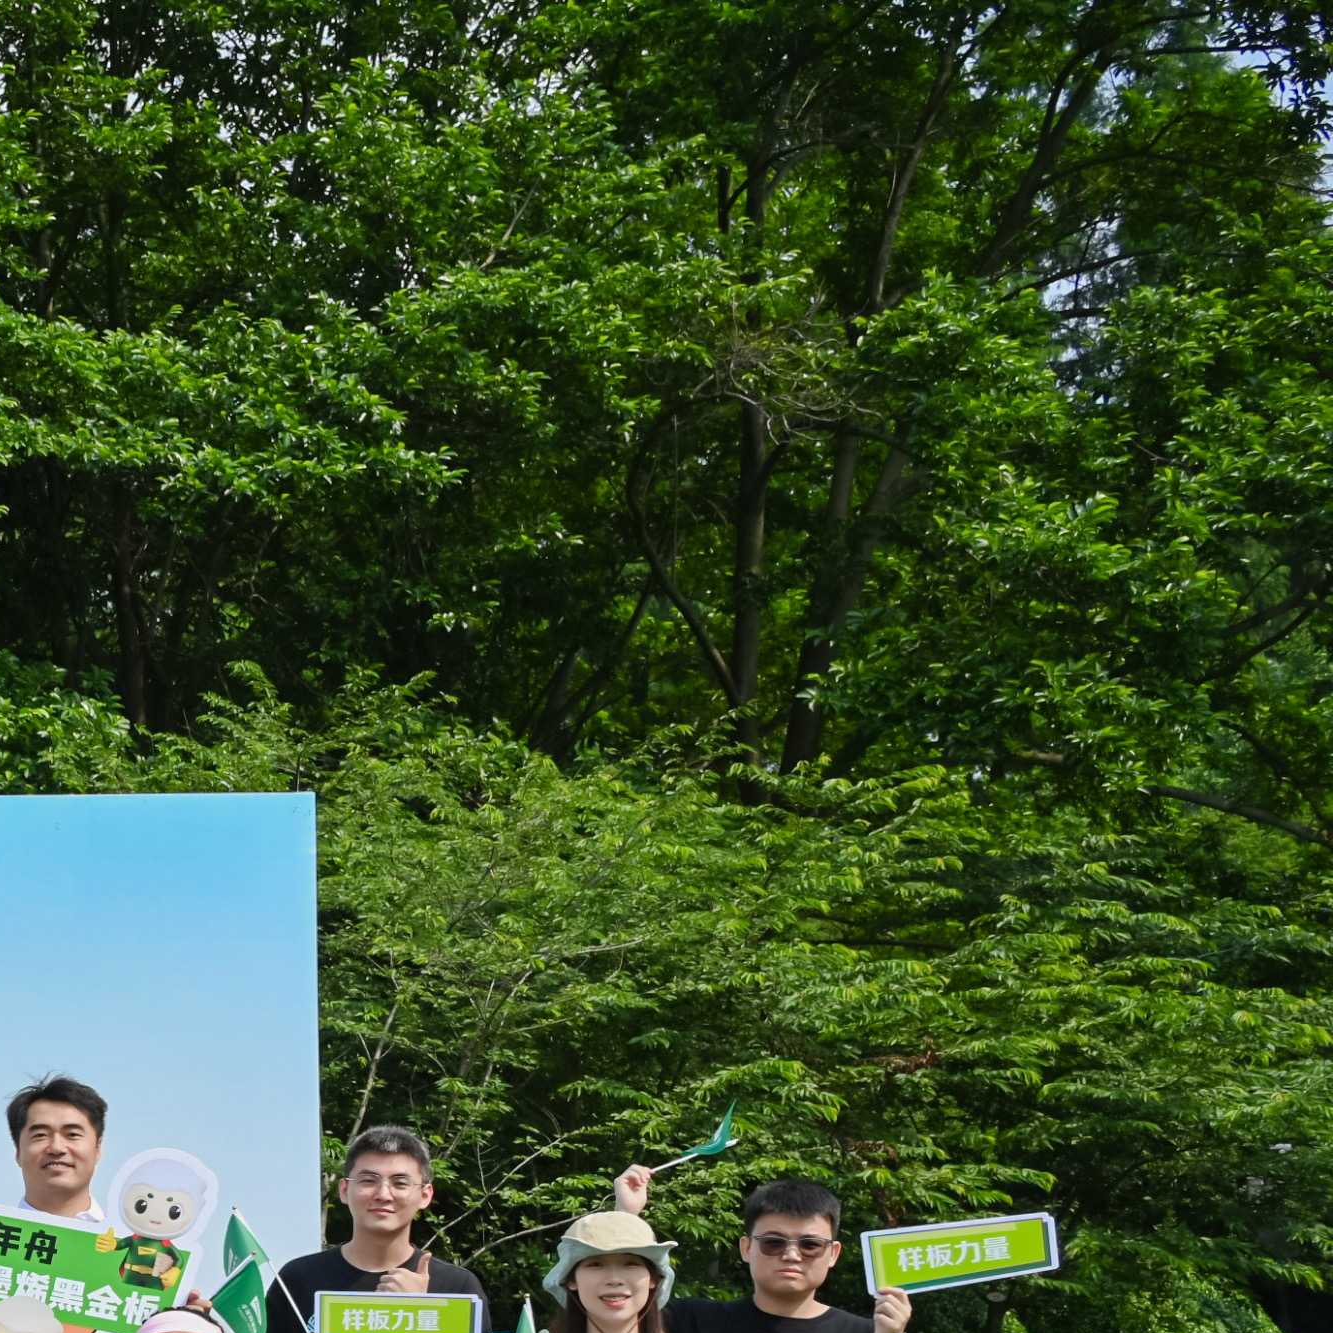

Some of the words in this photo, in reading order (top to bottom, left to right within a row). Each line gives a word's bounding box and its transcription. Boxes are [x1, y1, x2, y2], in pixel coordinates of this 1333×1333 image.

[897, 1236, 1011, 1272] 样板力量
[341, 1308, 441, 1331] 样板力量
